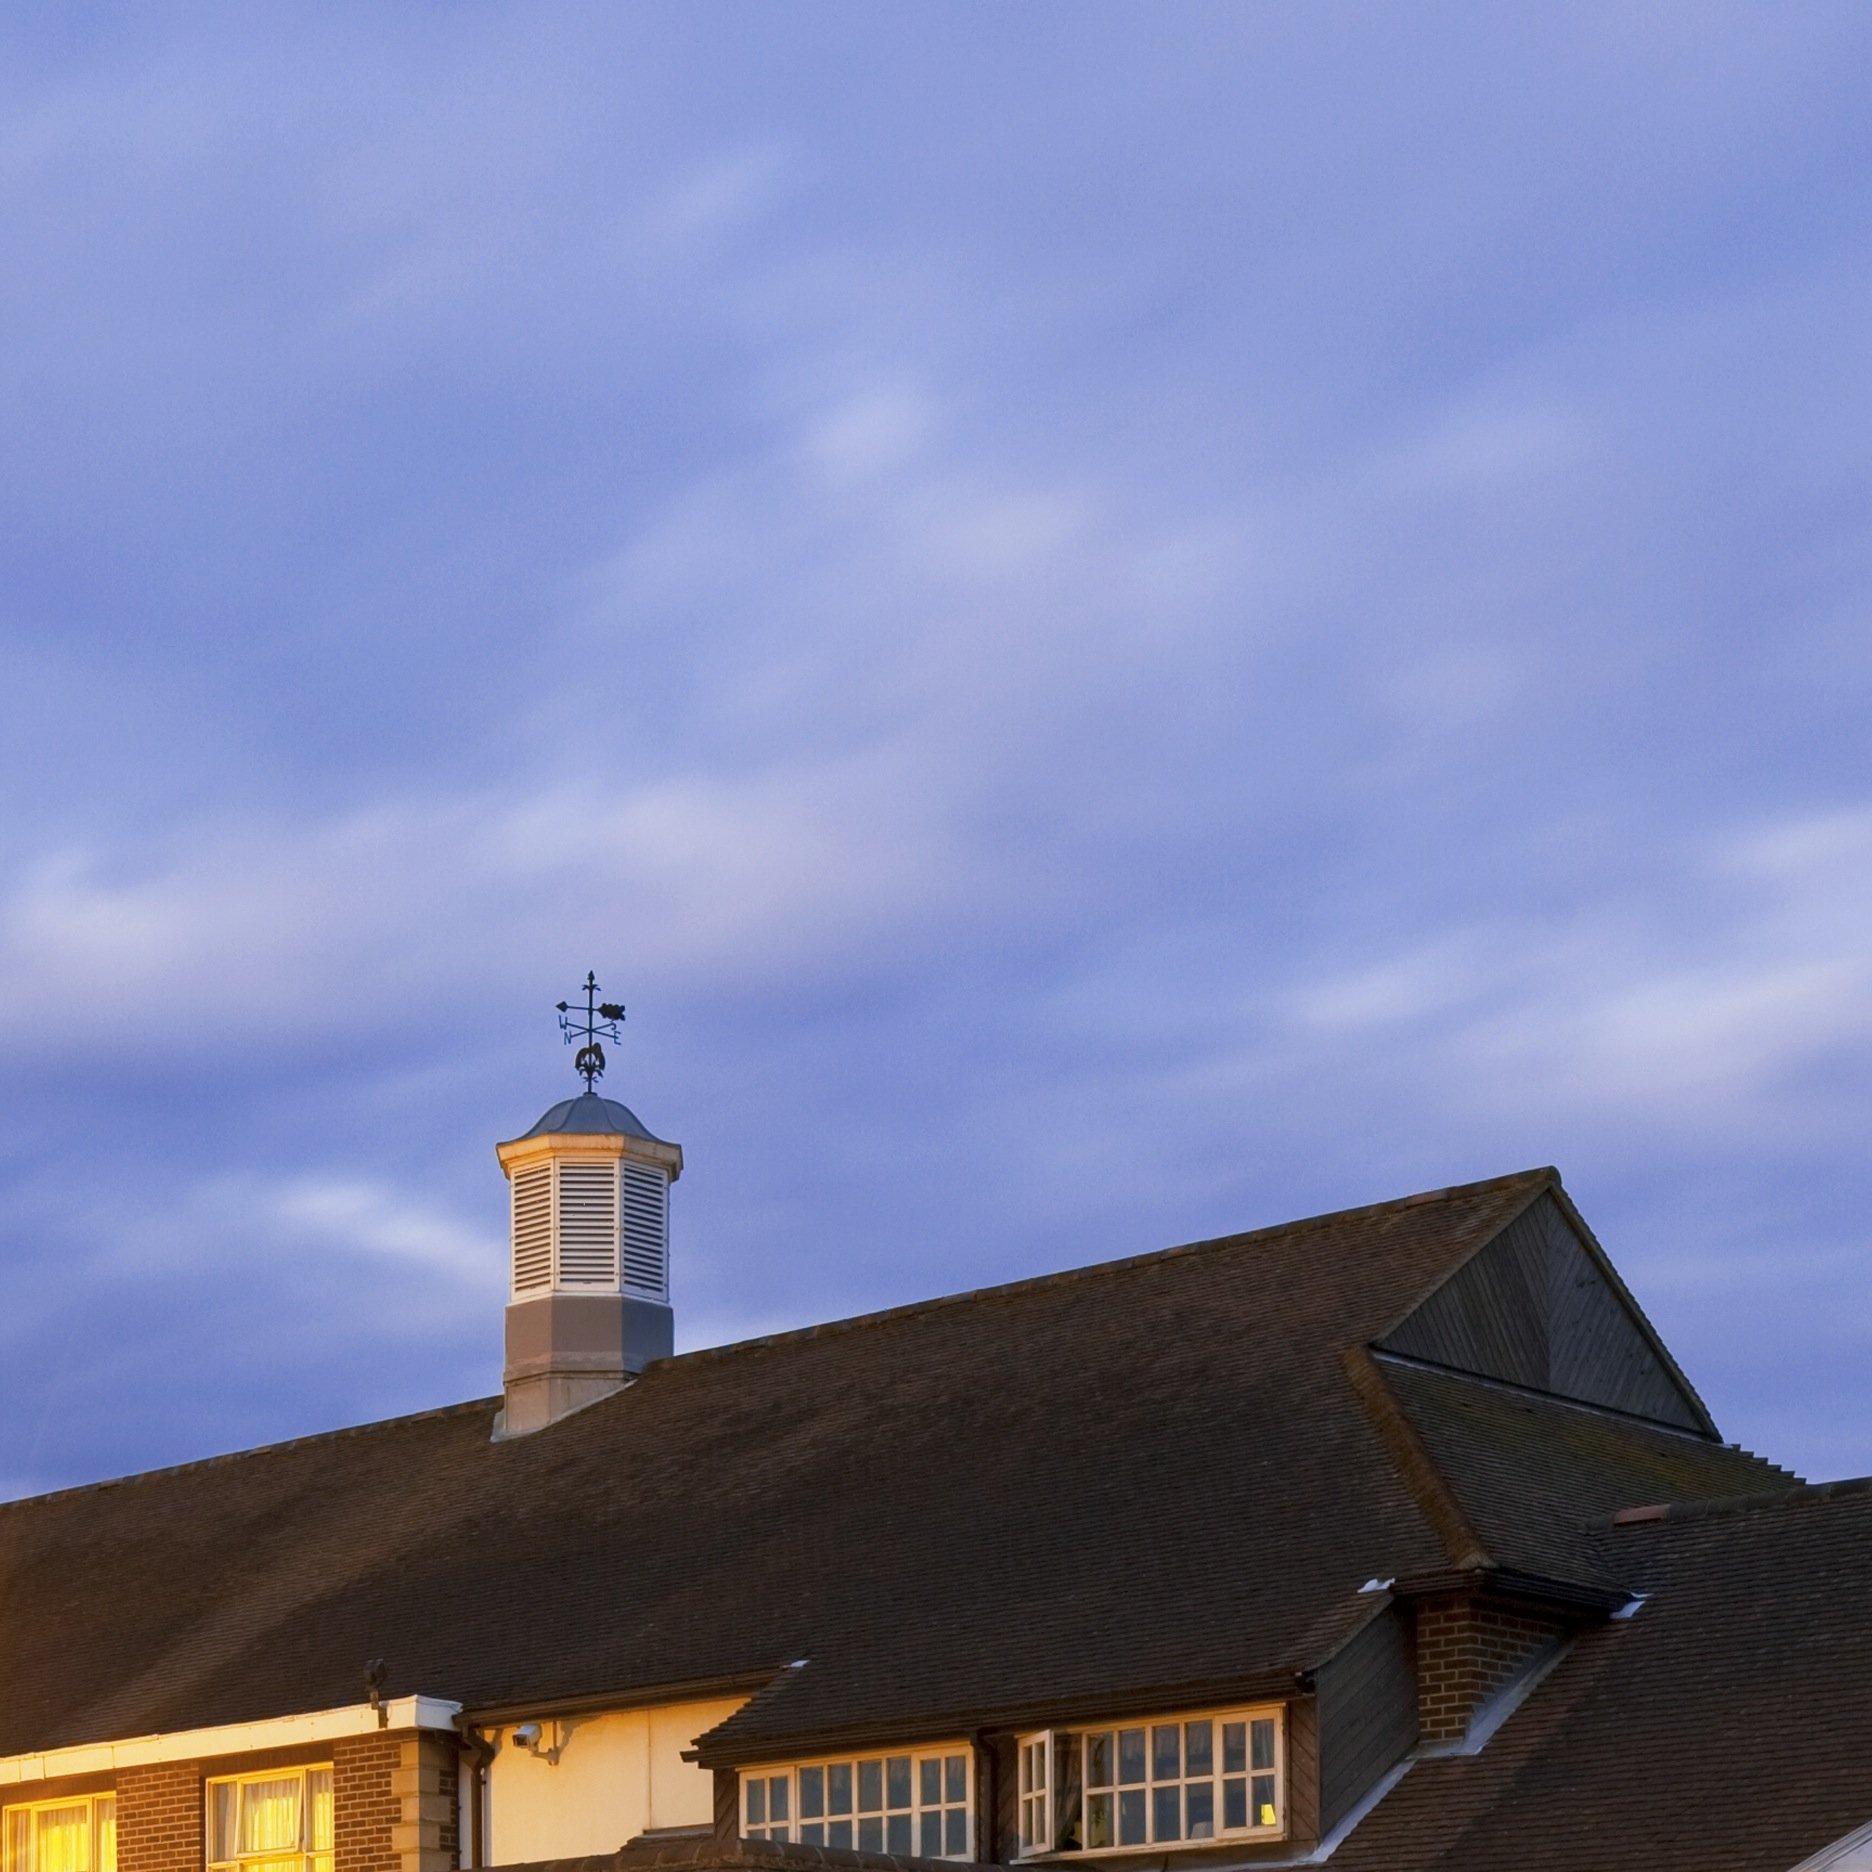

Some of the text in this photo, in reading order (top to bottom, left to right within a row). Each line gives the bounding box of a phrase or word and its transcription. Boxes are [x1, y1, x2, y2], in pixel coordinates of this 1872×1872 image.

[558, 1014, 568, 1030] W
[564, 1030, 572, 1046] N
[614, 1030, 622, 1046] E
